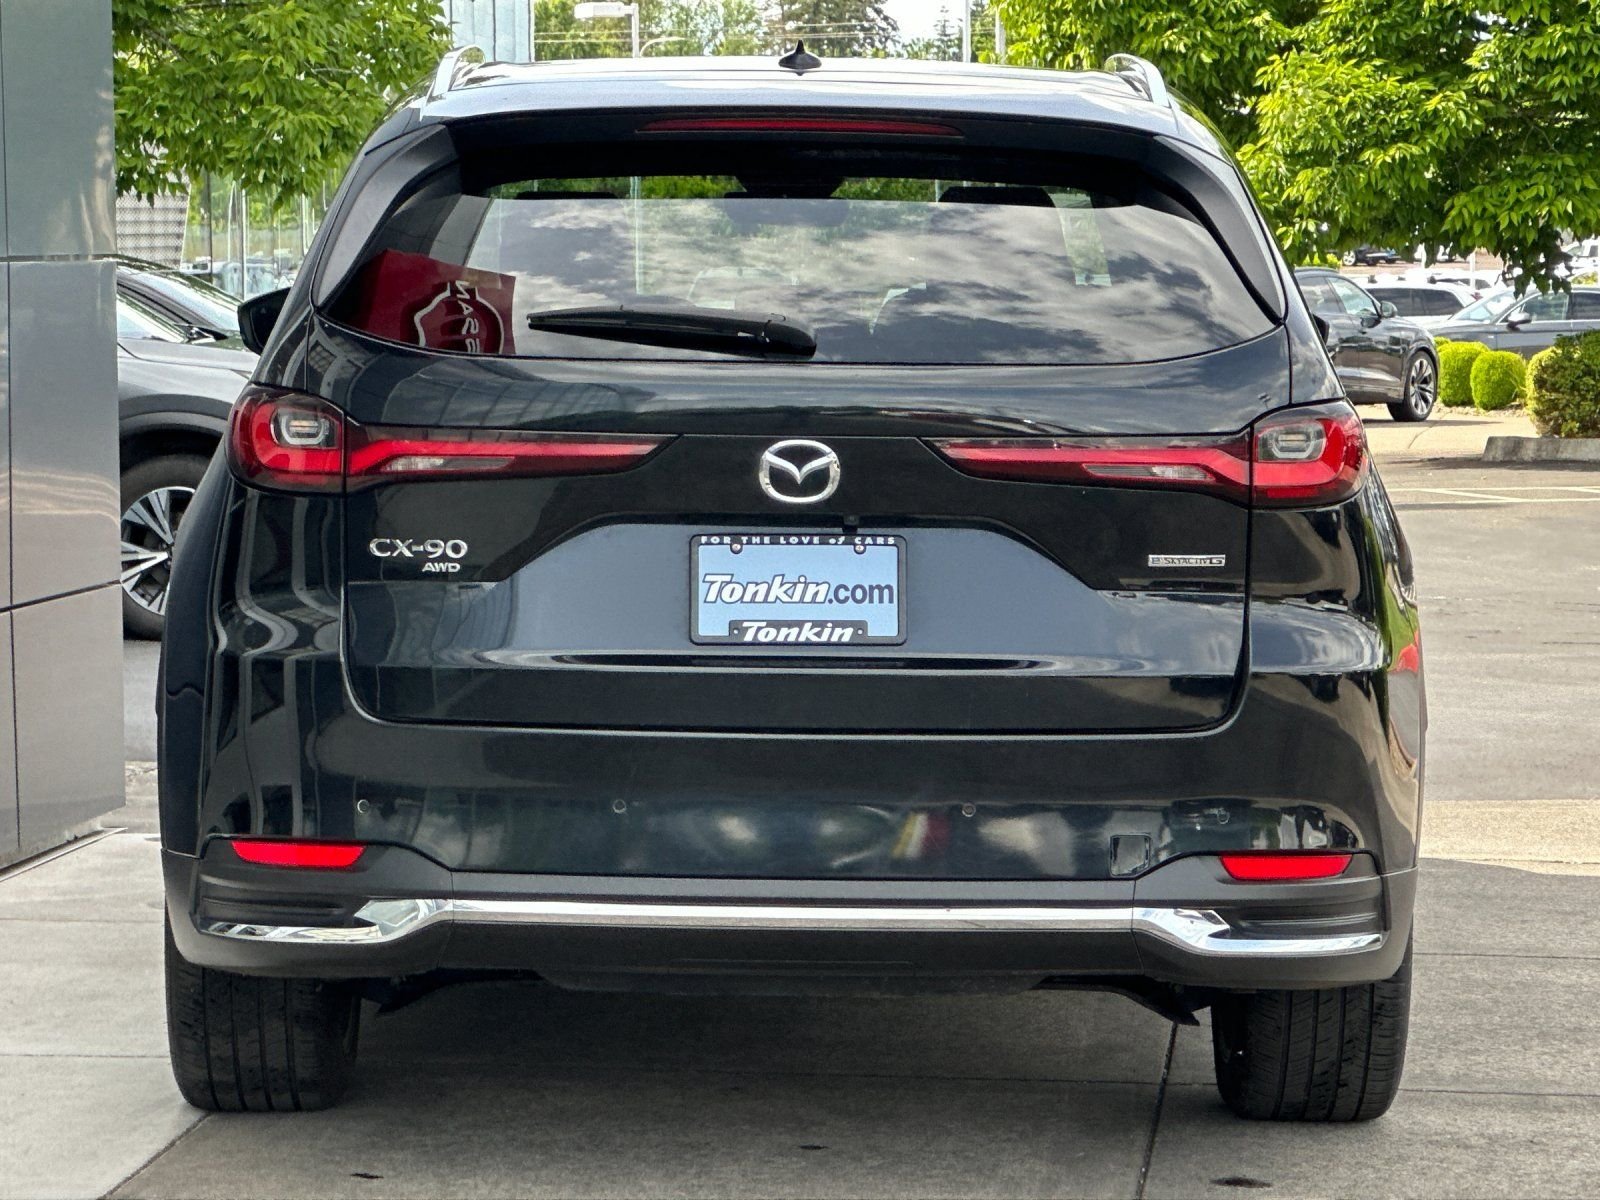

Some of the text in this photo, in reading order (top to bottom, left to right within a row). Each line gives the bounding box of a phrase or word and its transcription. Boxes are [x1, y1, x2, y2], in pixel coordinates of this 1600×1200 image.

[369, 538, 468, 558] CX-90
[701, 536, 731, 544] FOR
[741, 536, 770, 544] THE
[780, 536, 820, 544] LOVE
[855, 537, 895, 545] CARS
[421, 562, 461, 573] AWD
[702, 573, 895, 604] Tonkin.com
[741, 621, 854, 642] Tonkin
